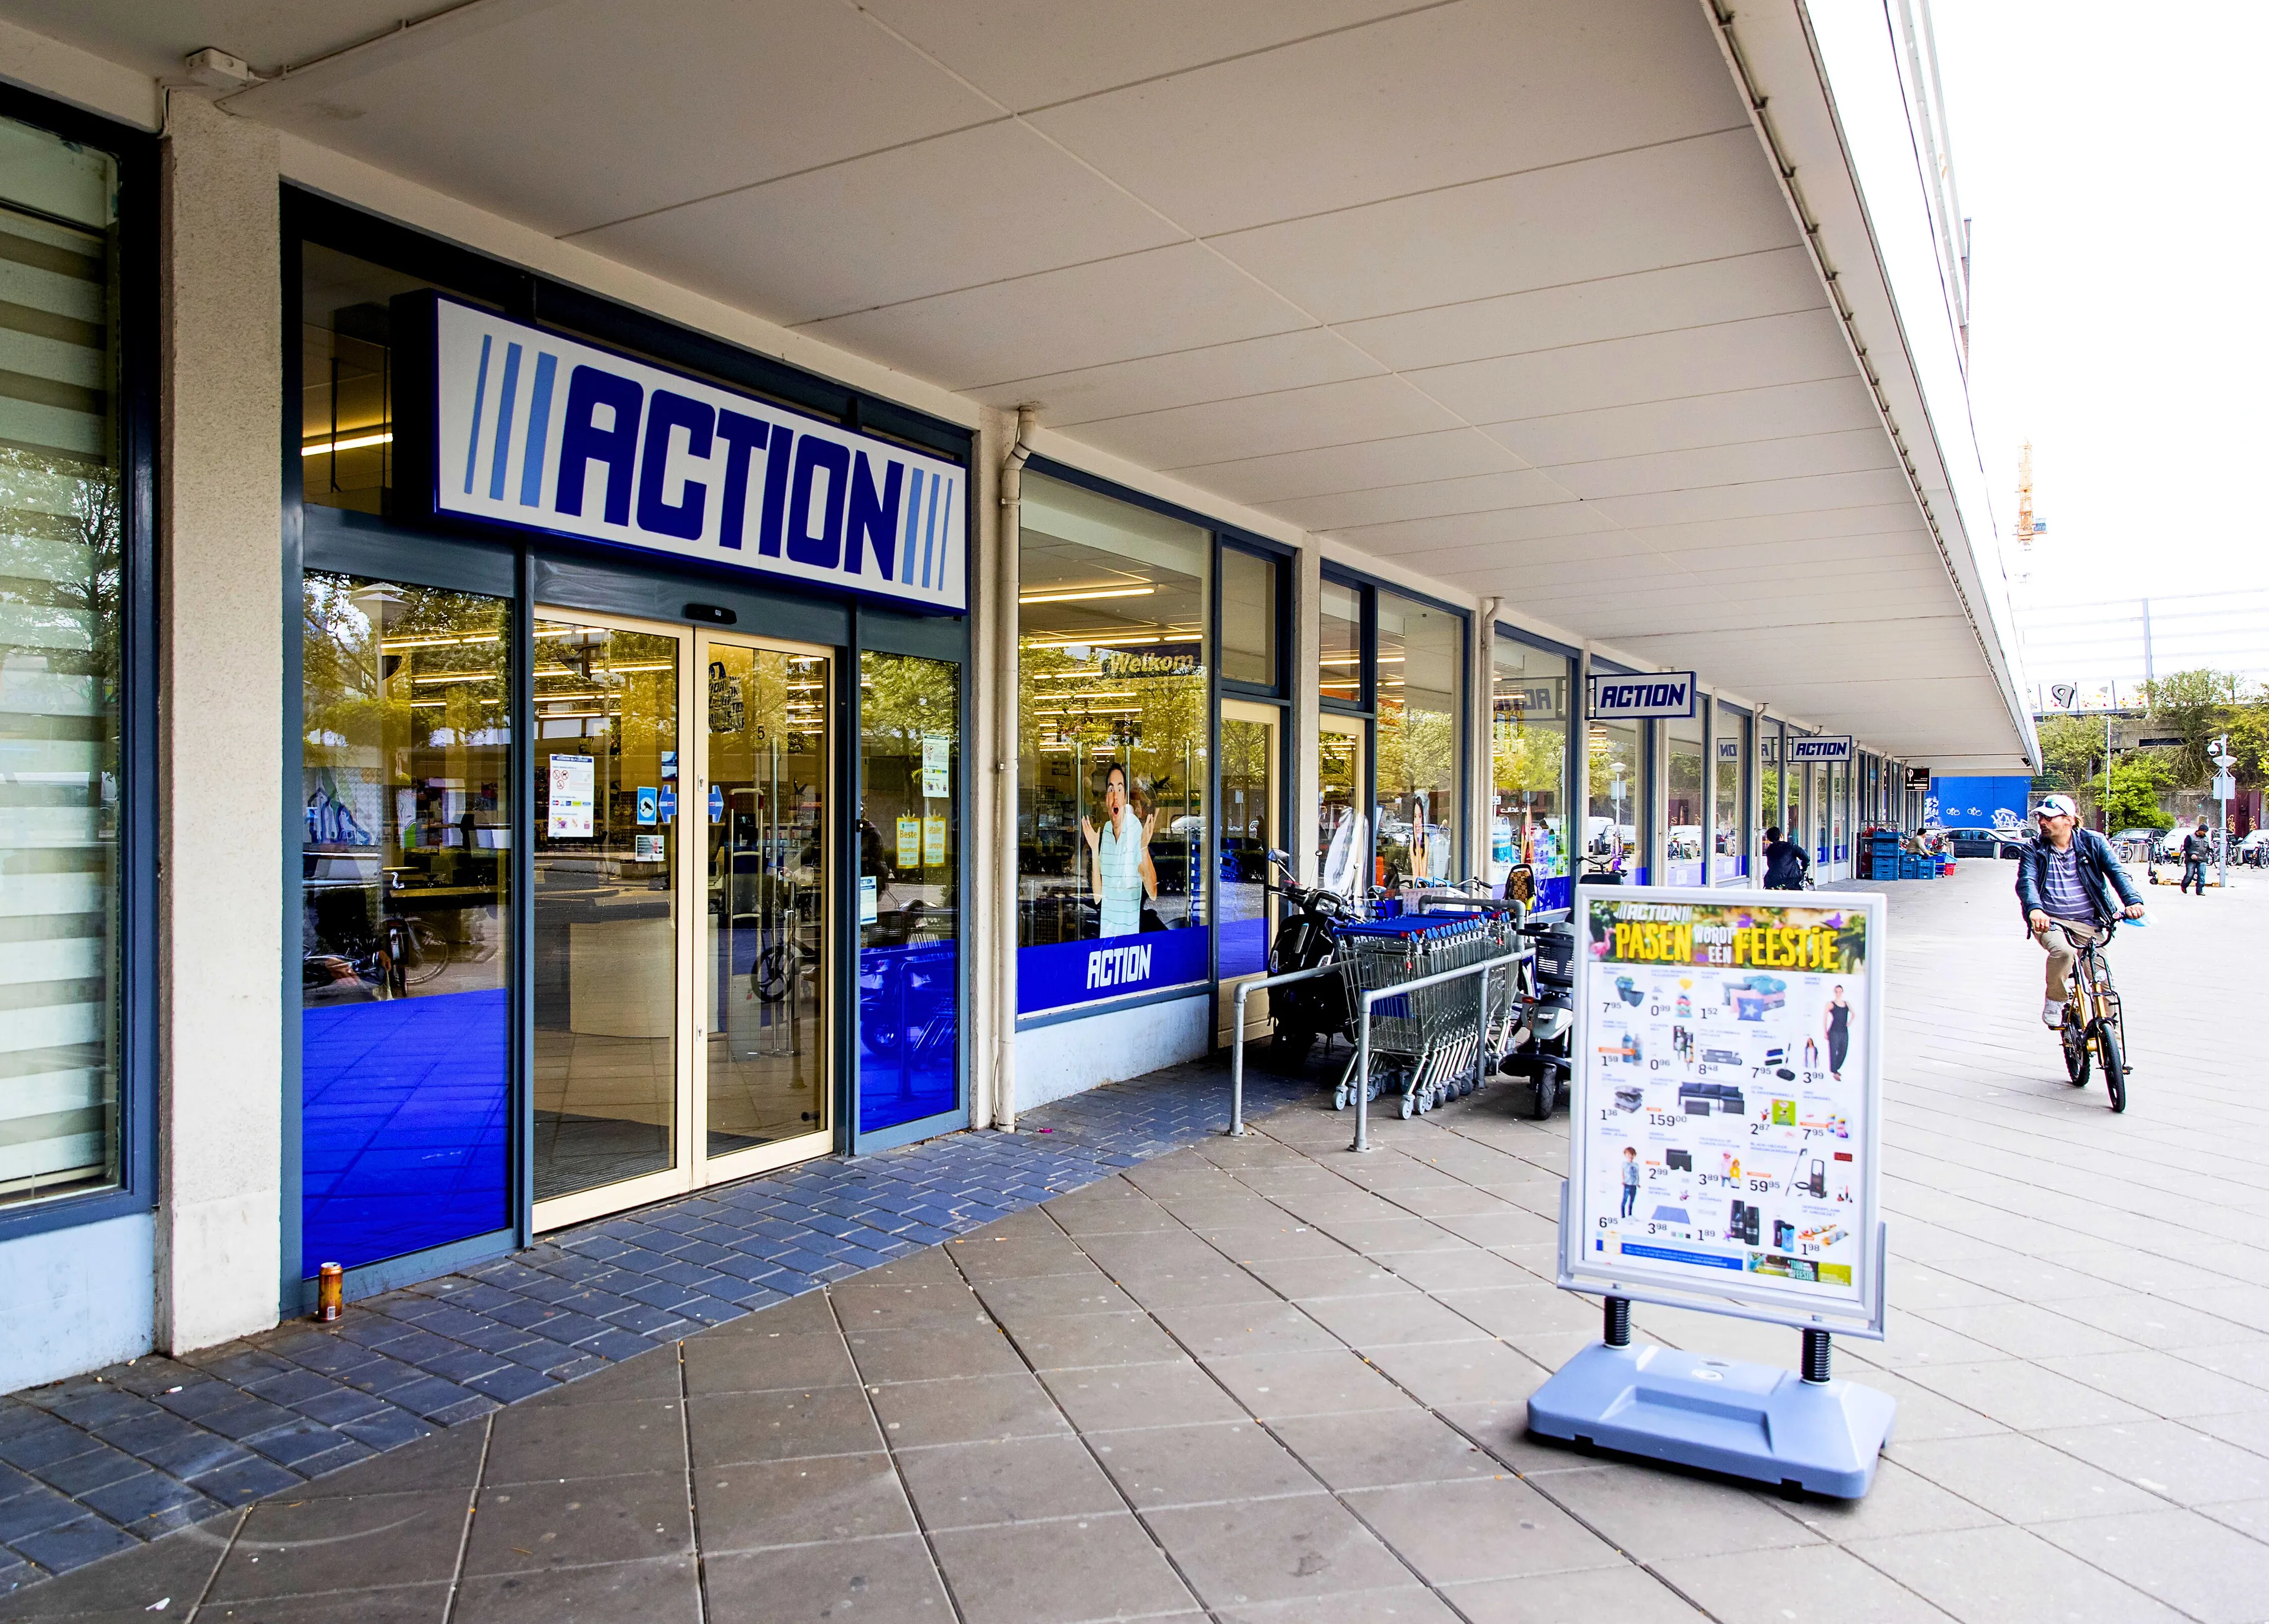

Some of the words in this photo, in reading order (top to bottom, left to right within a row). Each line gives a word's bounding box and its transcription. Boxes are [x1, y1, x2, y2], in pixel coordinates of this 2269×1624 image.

[555, 364, 903, 581] ACTION
[1110, 652, 1194, 674] Welkom
[1600, 684, 1686, 708] ACTION
[757, 725, 765, 740] 5
[1796, 742, 1847, 756] ACTION
[899, 829, 917, 838] Beste
[1626, 904, 1684, 922] ACTION
[1615, 923, 1692, 962] PASEN
[1692, 925, 1735, 946] WORDT
[1087, 943, 1152, 990] ACTION
